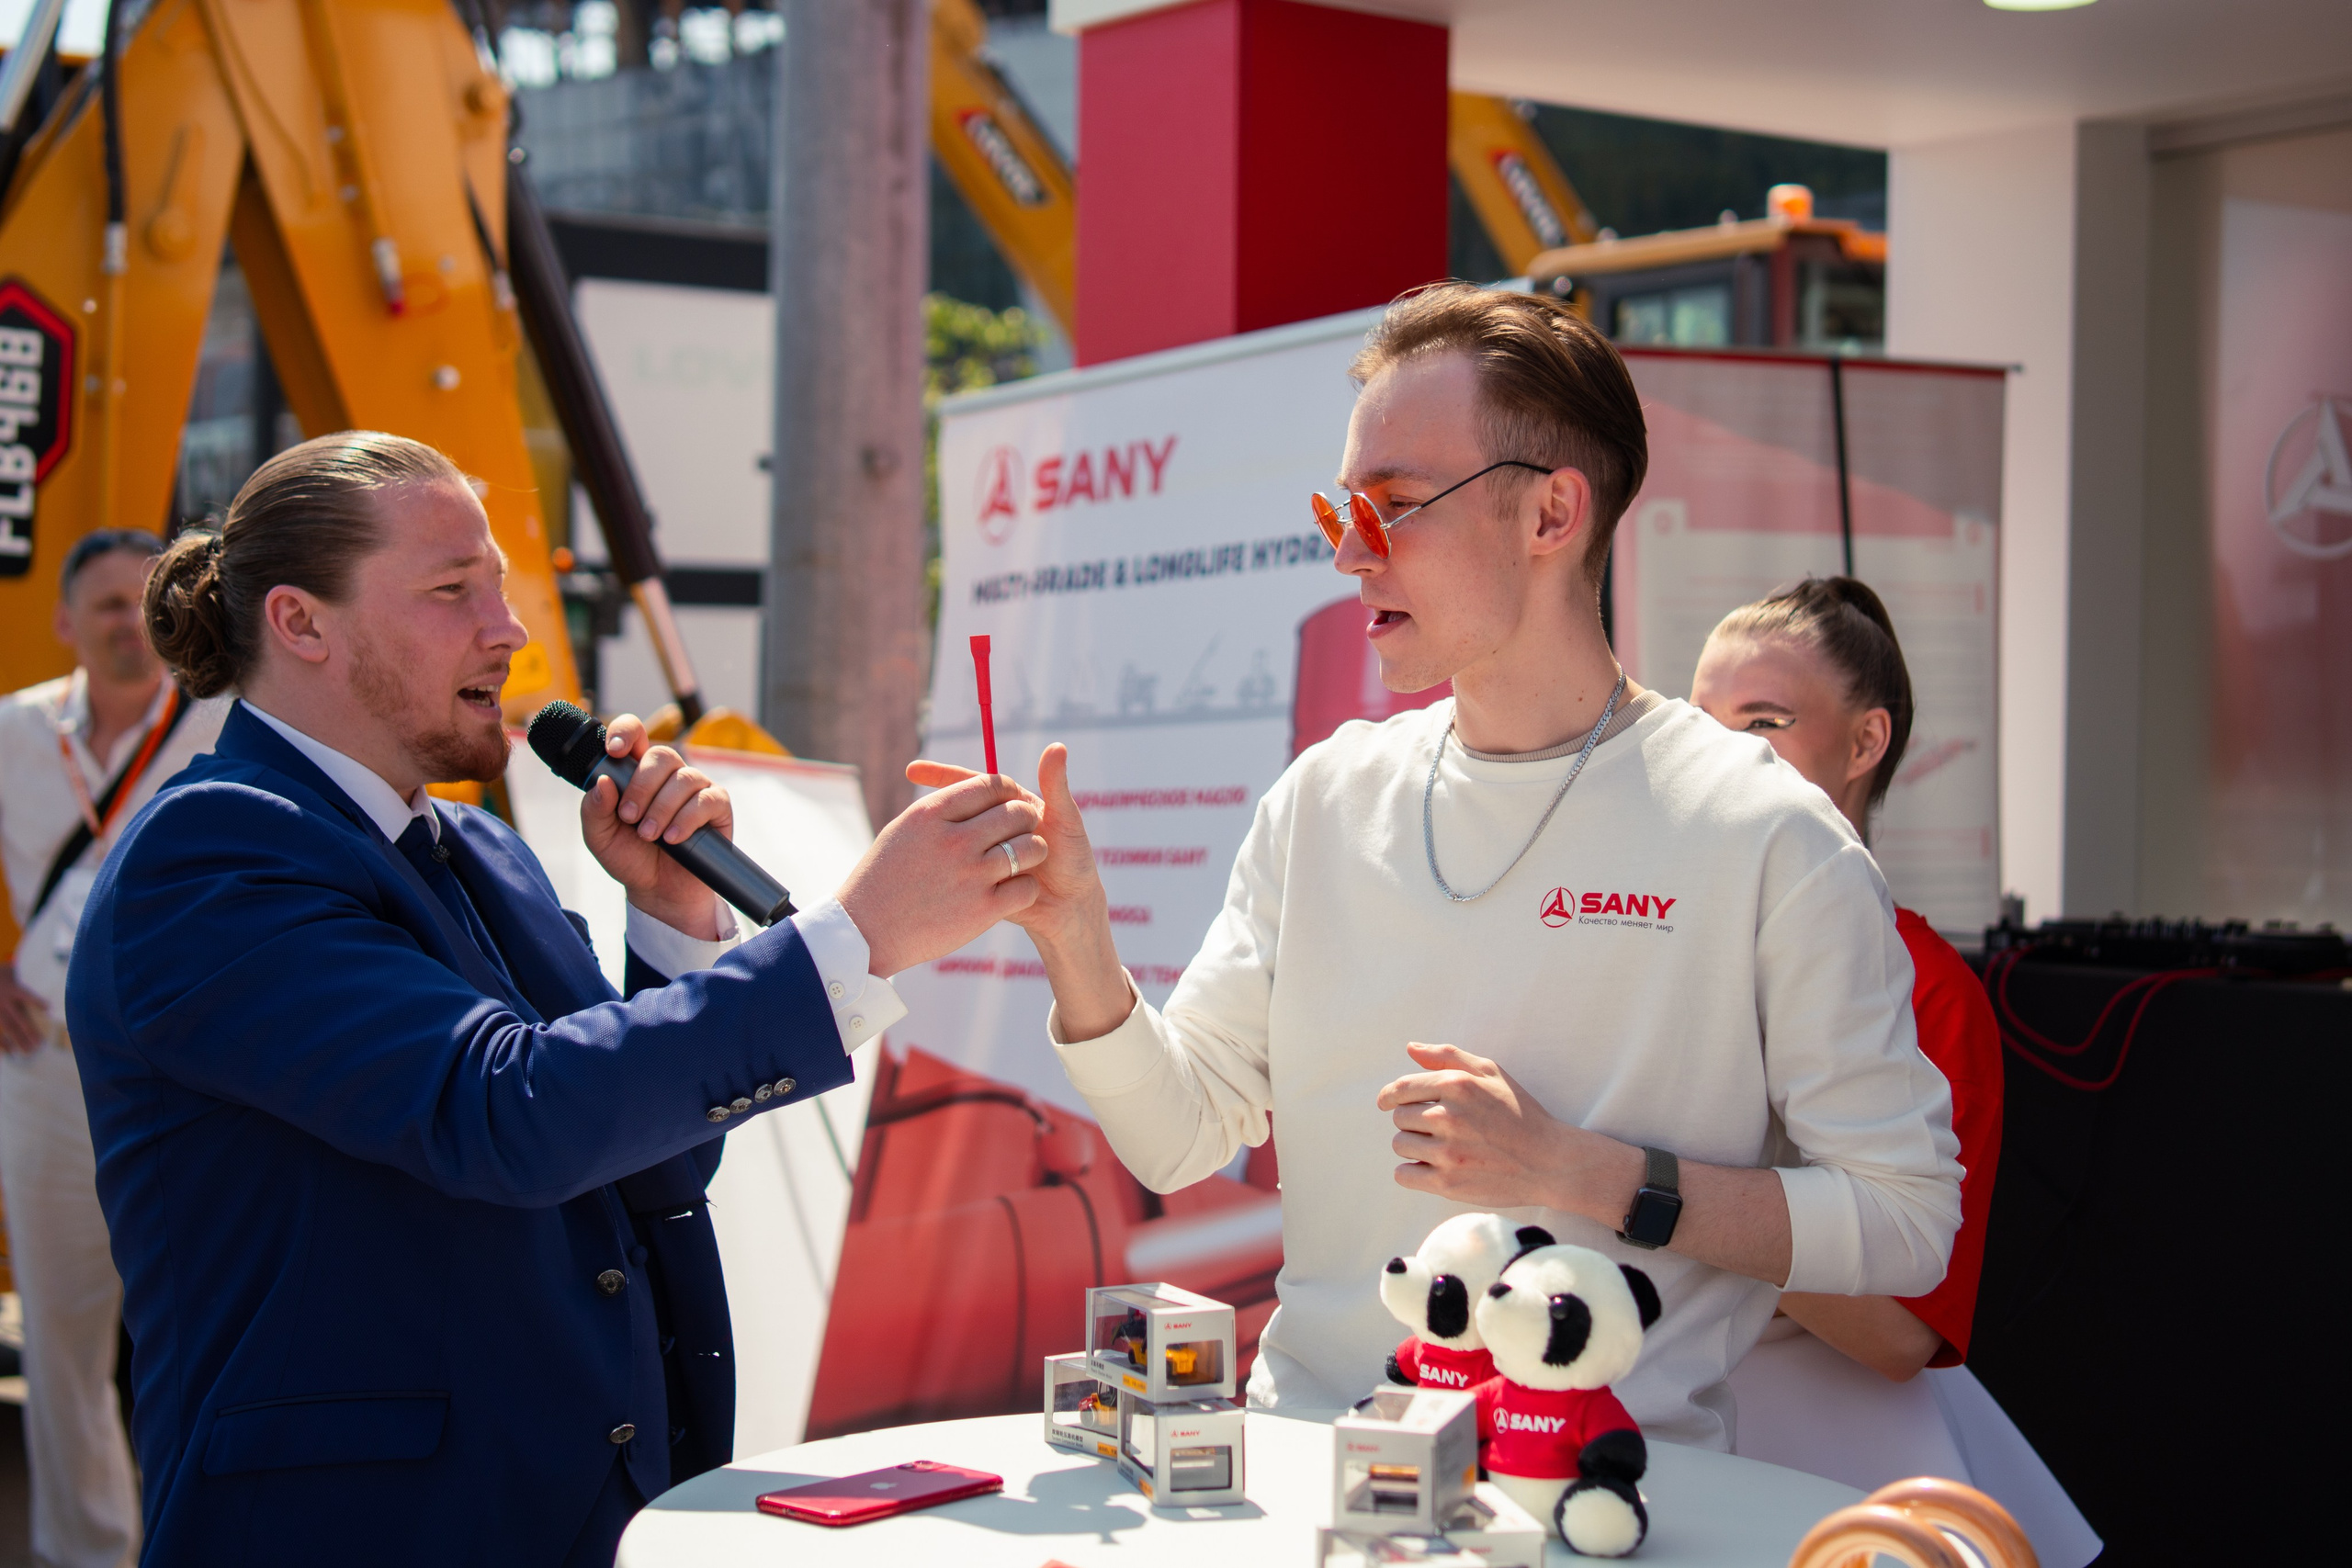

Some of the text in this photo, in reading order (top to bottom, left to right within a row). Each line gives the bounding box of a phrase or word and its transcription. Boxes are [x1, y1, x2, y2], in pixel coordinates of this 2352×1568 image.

[1034, 434, 1179, 512] SANY
[1133, 542, 1245, 588] LONGLIFE
[1580, 893, 1677, 919] SANY
[1578, 916, 1674, 933] Качество меняет мир
[1419, 1363, 1469, 1388] SANY
[1510, 1413, 1566, 1434] SANY
